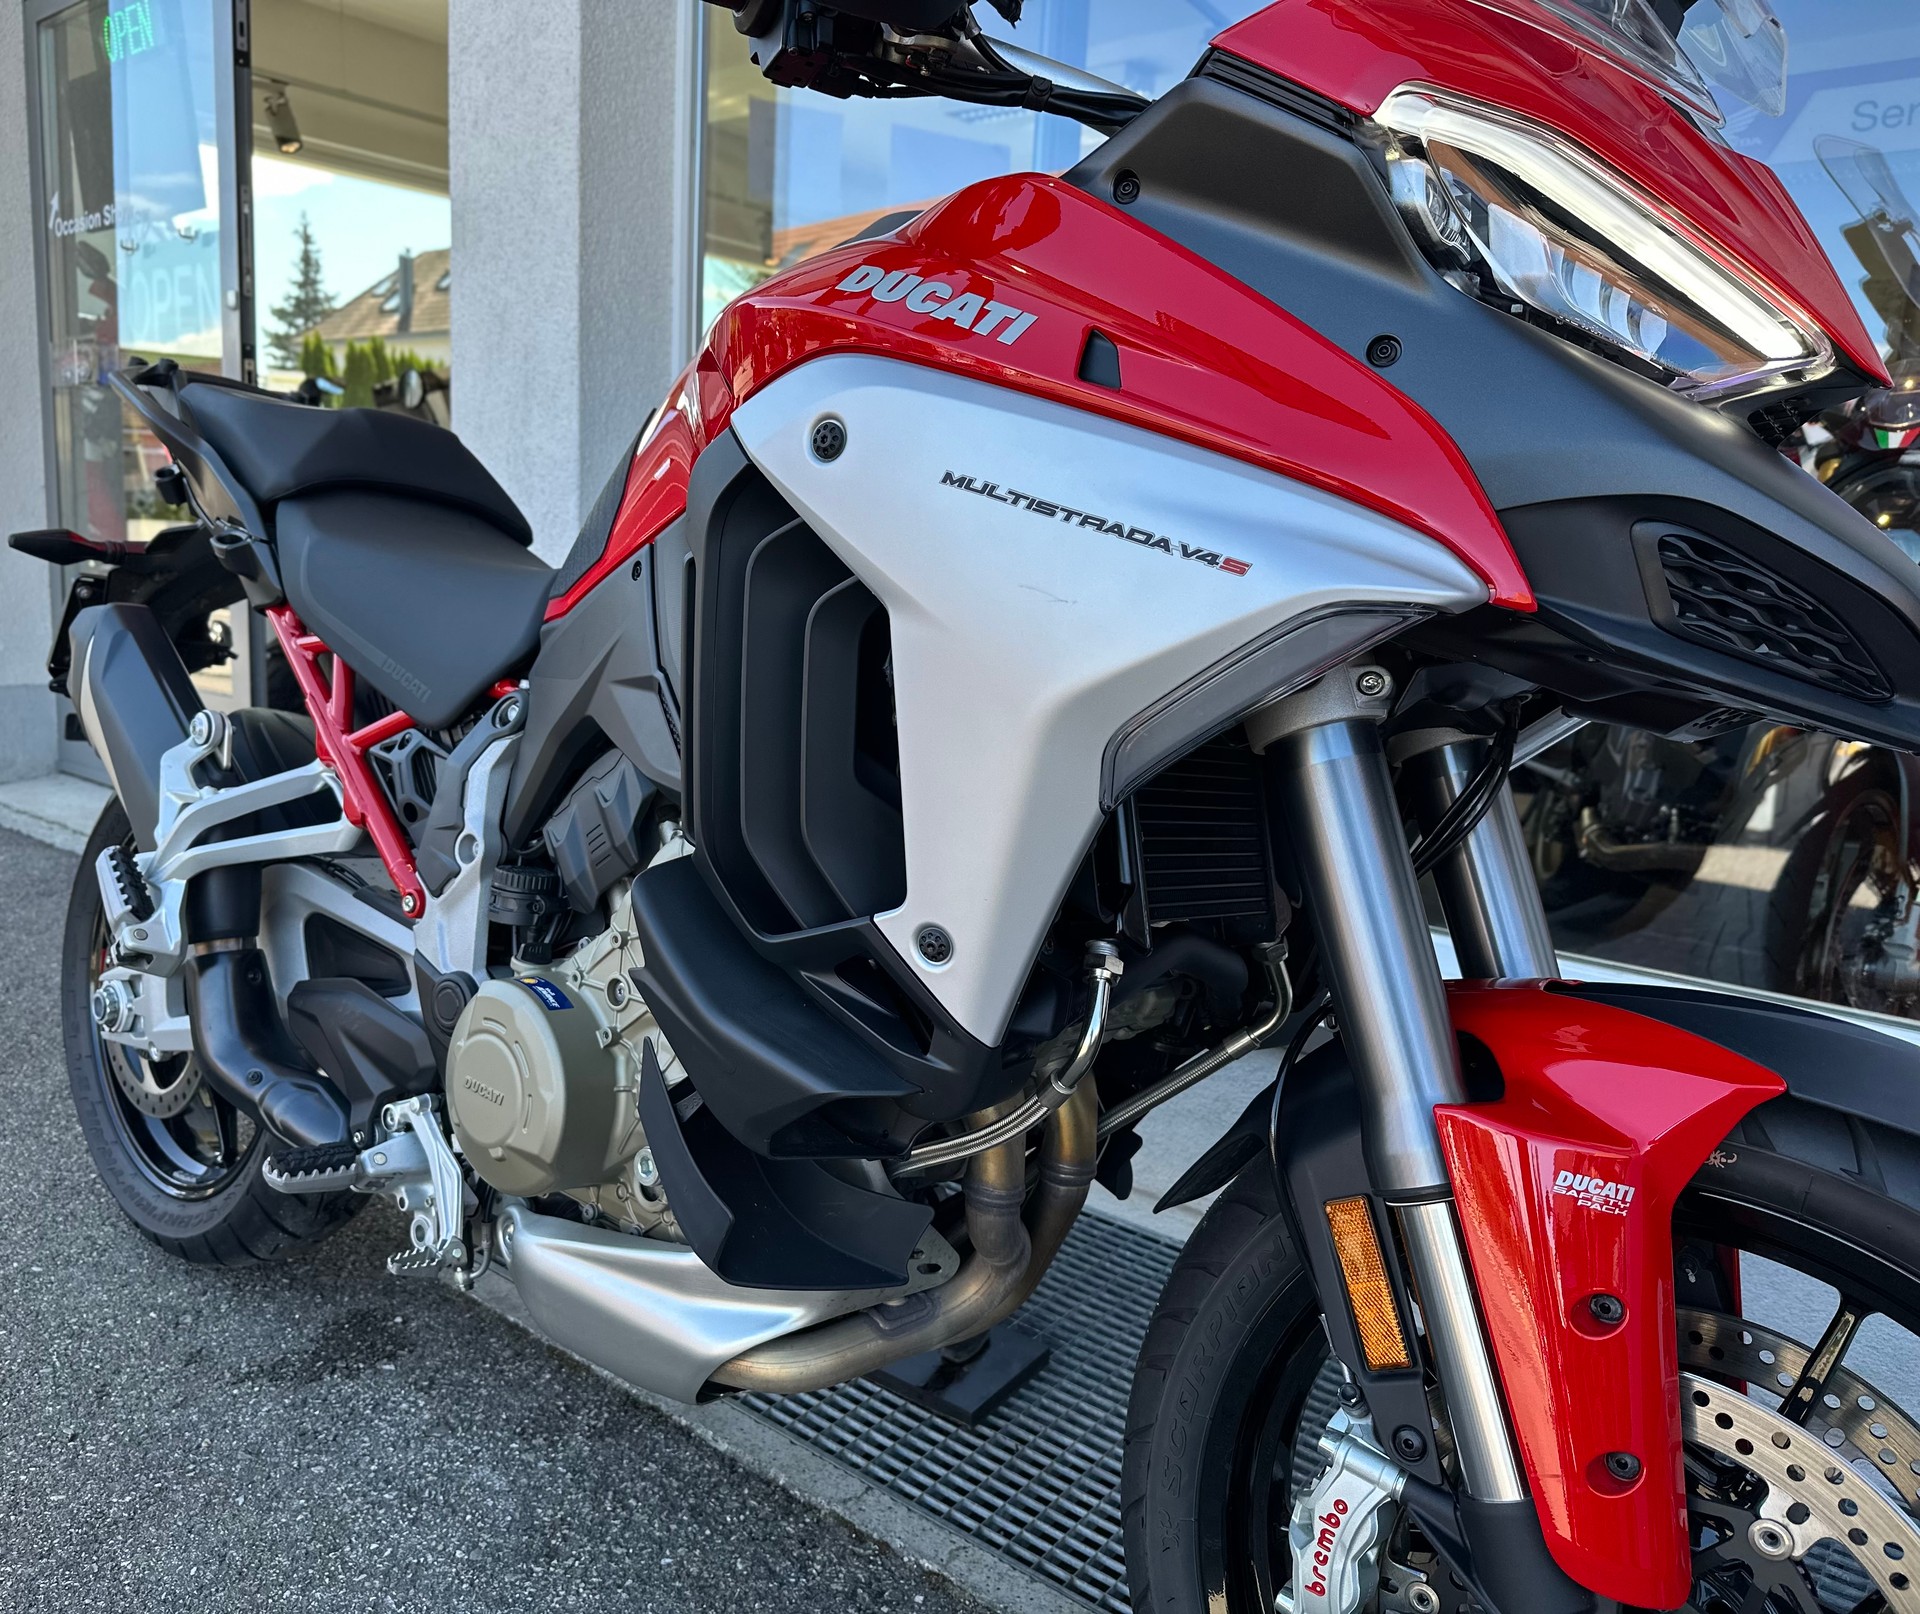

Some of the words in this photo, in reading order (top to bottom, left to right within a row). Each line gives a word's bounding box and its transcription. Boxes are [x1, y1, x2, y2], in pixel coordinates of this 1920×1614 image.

[103, 0, 153, 62] OPEN
[55, 211, 101, 237] Occasion
[127, 262, 220, 339] OPEN
[835, 265, 1039, 346] DUCATI
[939, 470, 1174, 557] MULTISTRADA
[382, 657, 432, 703] DUCATI
[464, 1075, 505, 1106] DUCATI
[1552, 1185, 1630, 1208] SAFETY
[1555, 1170, 1635, 1202] DUCATI
[1577, 1199, 1628, 1217] PACK
[1160, 1234, 1288, 1498] SCORPION
[1304, 1498, 1349, 1597] brembo
